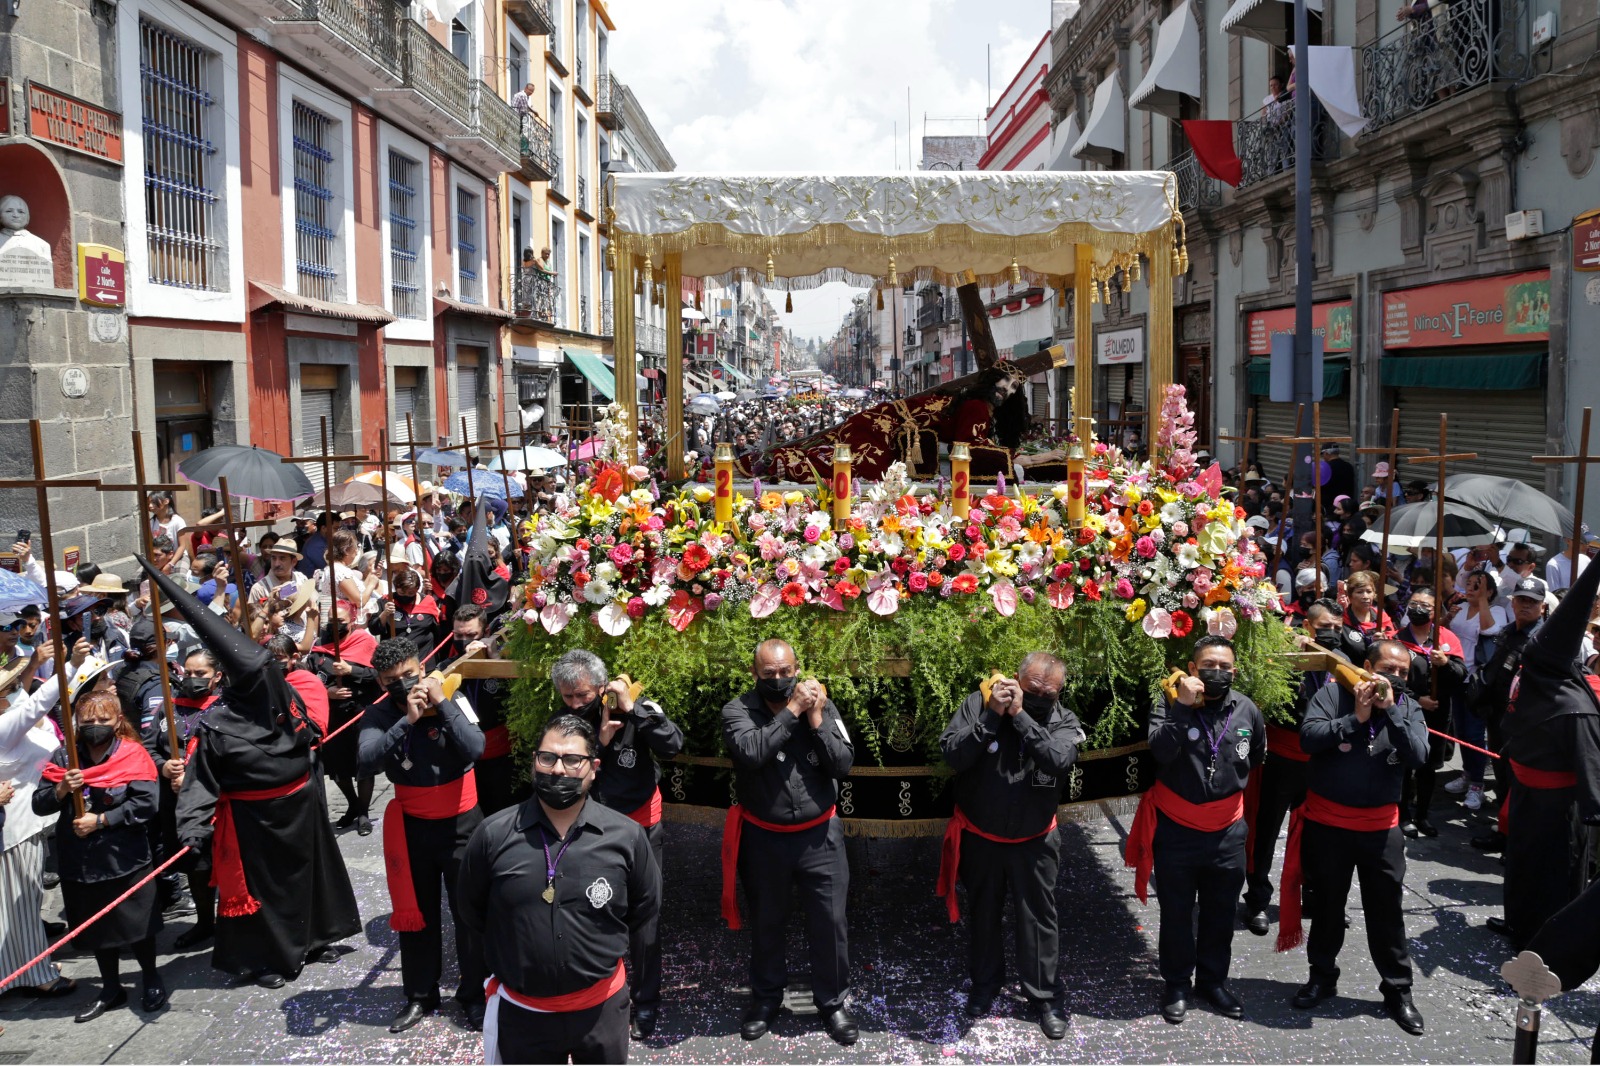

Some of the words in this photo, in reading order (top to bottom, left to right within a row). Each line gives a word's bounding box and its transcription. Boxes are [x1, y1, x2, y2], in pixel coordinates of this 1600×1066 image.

[31, 88, 68, 120] MONTE
[70, 101, 85, 125] DE
[1584, 241, 1589, 251] 2
[96, 275, 101, 286] 2
[101, 276, 116, 288] Norte
[1469, 304, 1503, 325] Ferré
[696, 333, 715, 355] H
[1111, 337, 1135, 355] OLMEDO
[716, 469, 730, 498] 2
[834, 471, 849, 501] 0
[953, 470, 968, 500] 2
[1069, 470, 1083, 501] 3
